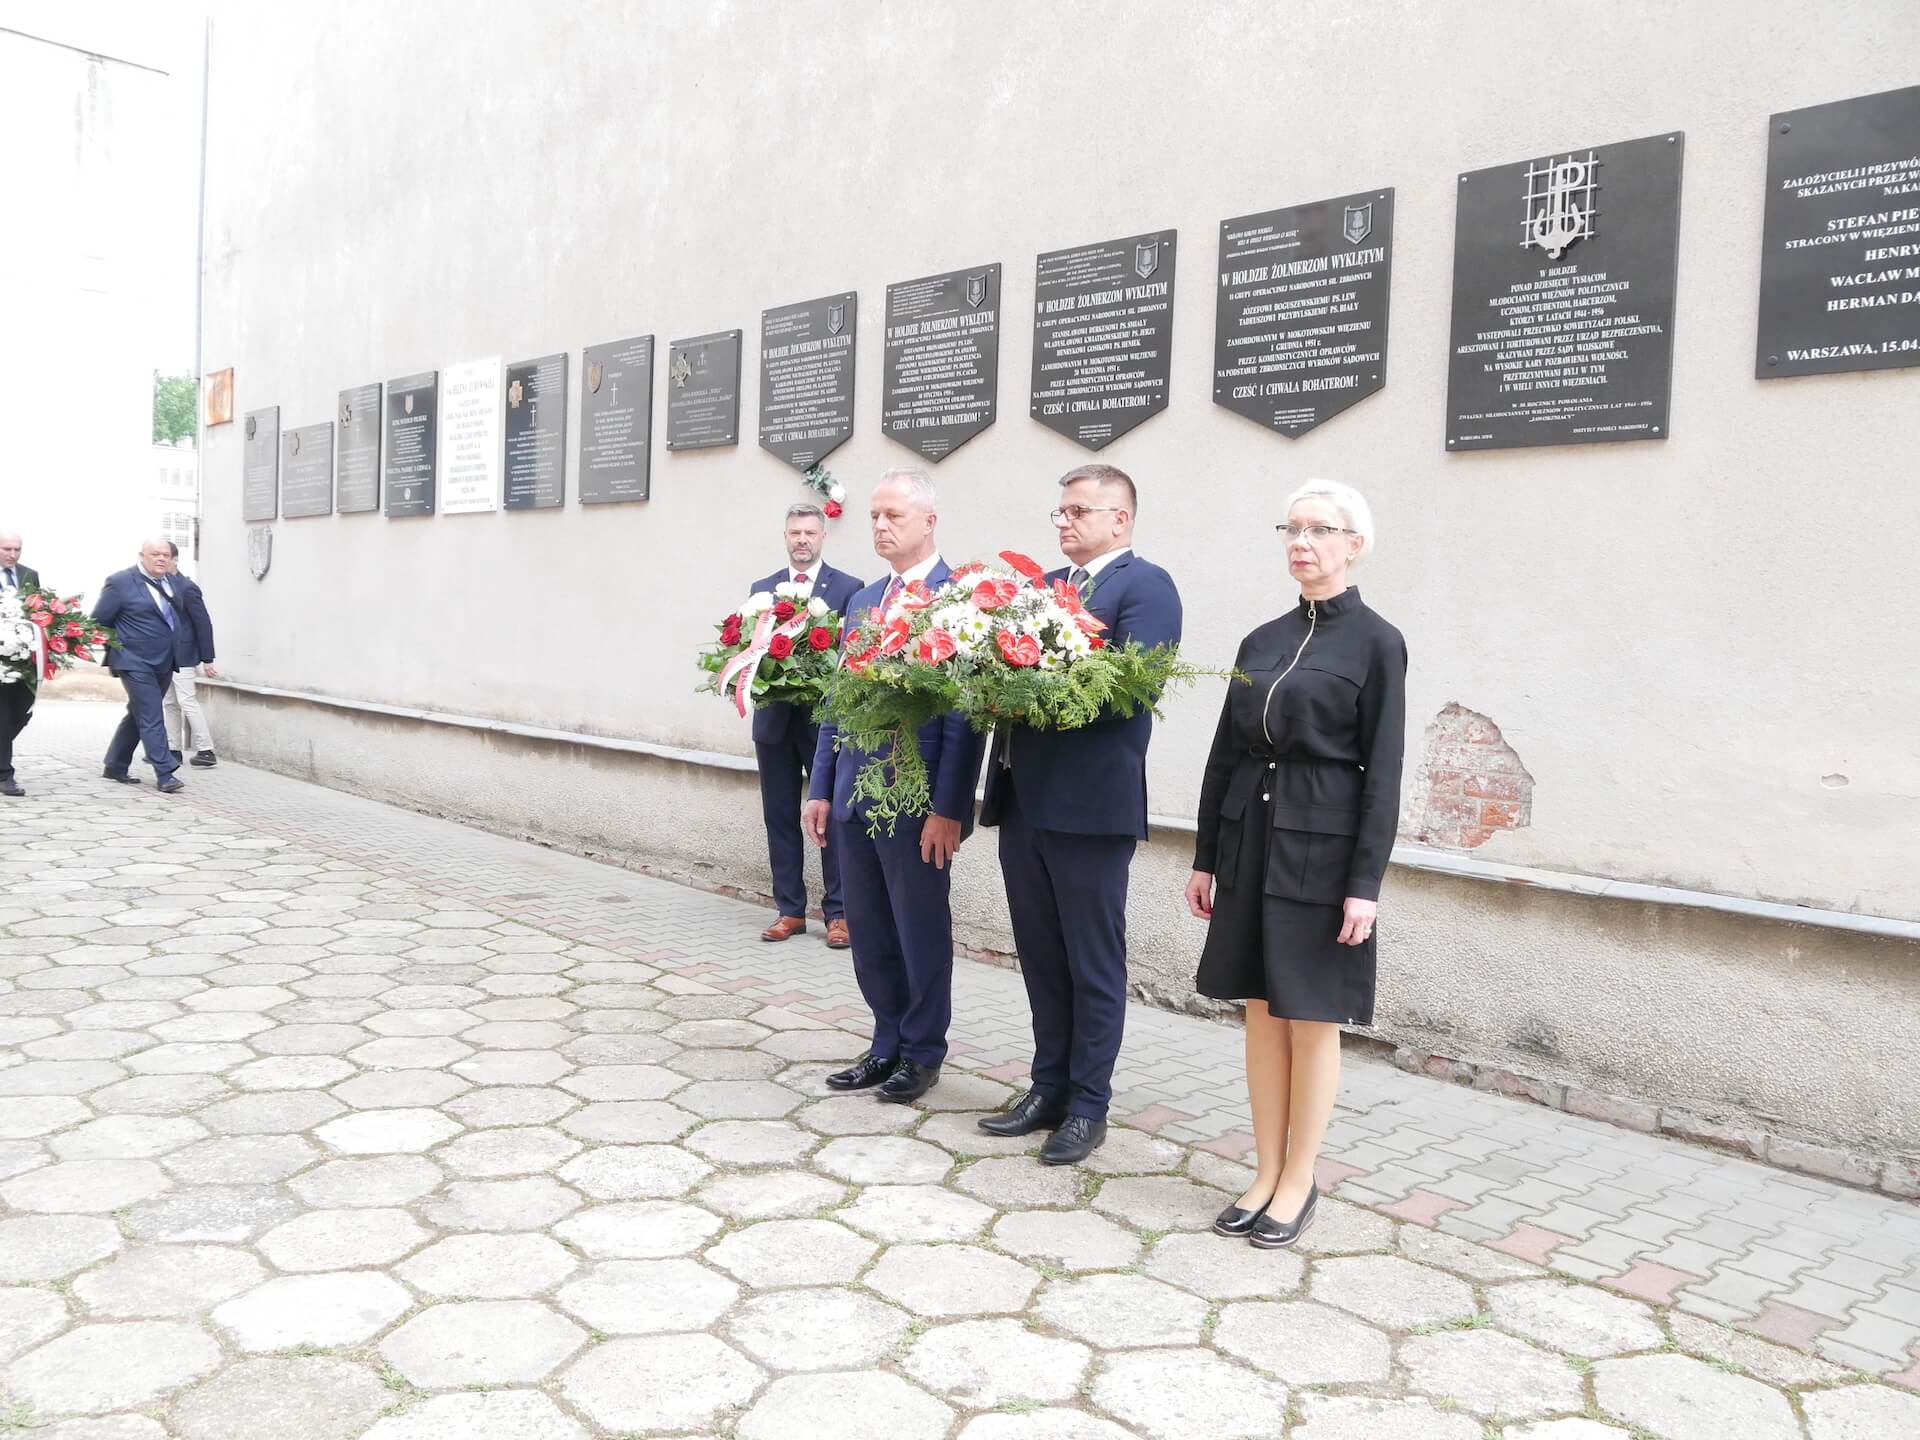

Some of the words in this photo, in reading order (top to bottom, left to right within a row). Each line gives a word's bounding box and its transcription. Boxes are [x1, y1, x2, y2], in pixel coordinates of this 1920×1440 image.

[1860, 167, 1866, 177] I
[1797, 178, 1867, 198] SKAZANYCH
[1868, 171, 1907, 188] PRZEZ
[1884, 184, 1900, 196] NA
[1901, 180, 1920, 193] KA
[1828, 211, 1889, 231] STEFAN
[1785, 233, 1848, 249] STRACONY
[1849, 231, 1861, 241] W
[1221, 272, 1230, 287] W
[1331, 247, 1384, 269] WYKLĘTYM
[1539, 269, 1546, 278] W
[1511, 282, 1532, 293] PONAD
[1573, 272, 1607, 284] TYSIĄCOM
[1830, 269, 1903, 287] WACŁAW
[1578, 281, 1630, 296] POLITYCZNYCH
[1037, 301, 1044, 314] W
[1827, 293, 1898, 311] HERMAN
[1538, 314, 1544, 322] W
[1546, 310, 1572, 321] LATACH
[1477, 329, 1520, 341] WYSTĘPOWALI
[1523, 324, 1561, 336] PRZECIWKO
[1563, 318, 1612, 332] SOWIETYZACJI
[1227, 333, 1277, 347] ZAMORDOWANYM
[1279, 332, 1286, 340] W
[1276, 340, 1303, 350] GRUDNIA
[1457, 342, 1499, 353] ARESZTOWANI
[1506, 336, 1551, 348] TORTUROWANI
[1553, 334, 1575, 344] PRZEZ
[1238, 356, 1257, 366] PRZEZ
[1258, 349, 1318, 363] KOMUNISTYCZNYCH
[1496, 349, 1532, 360] SKAZYWANI
[1535, 346, 1556, 356] PRZEZ
[1577, 340, 1615, 352] WOJSKOWE
[1787, 343, 1879, 361] WARSZAWA,
[1483, 364, 1492, 372] NA
[1494, 360, 1523, 371] WYSOKIE
[1525, 358, 1542, 368] KARY
[1545, 354, 1589, 366] POZBAWIENIA
[1503, 369, 1561, 382] PRZETRZYMYWANI
[1581, 365, 1588, 374] W
[1590, 364, 1605, 374] TYM
[1233, 382, 1257, 399] CZEŚĆ
[1260, 384, 1264, 396] I
[1504, 383, 1511, 391] W
[1513, 381, 1534, 391] WIELU
[1535, 379, 1560, 389] INNYCH
